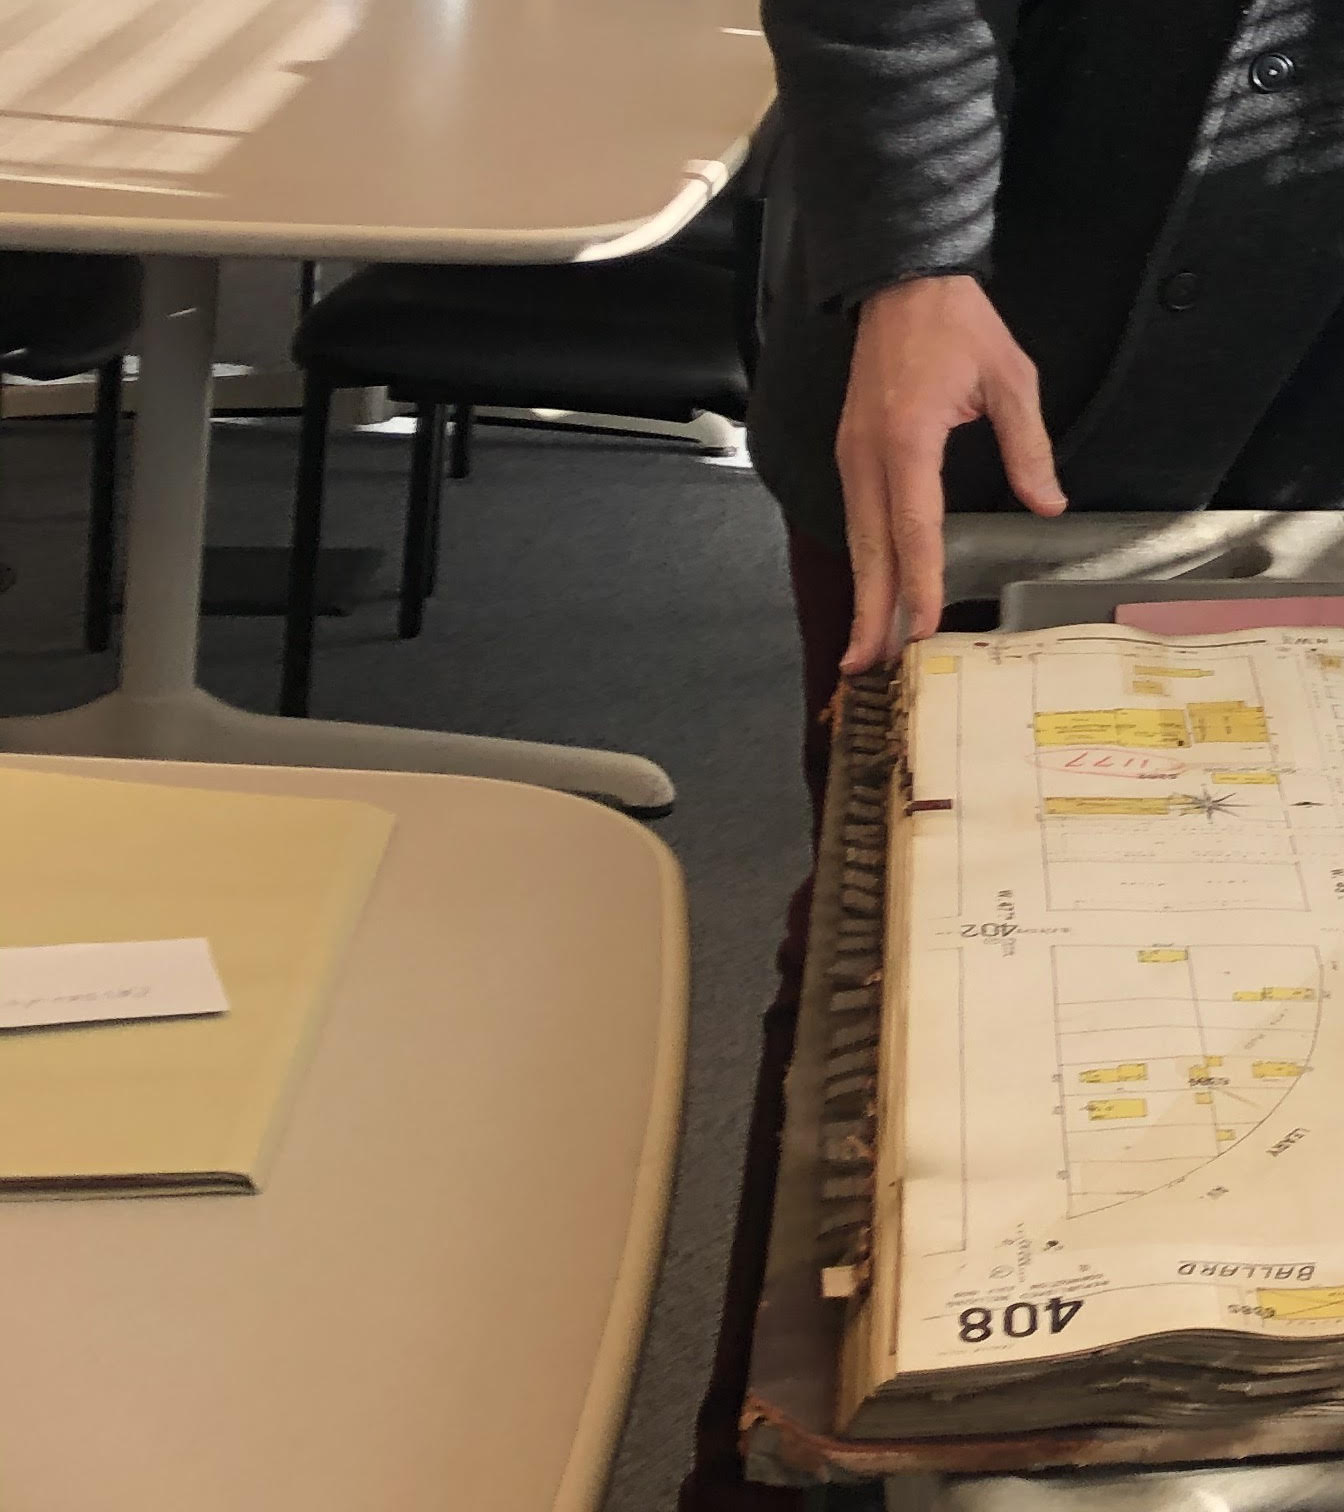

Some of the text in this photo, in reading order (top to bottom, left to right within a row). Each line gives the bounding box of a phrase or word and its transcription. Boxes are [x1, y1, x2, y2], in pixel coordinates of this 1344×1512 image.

[960, 923, 1018, 938] 402
[1177, 1263, 1315, 1281] BALLARD
[958, 1296, 1084, 1344] 408
